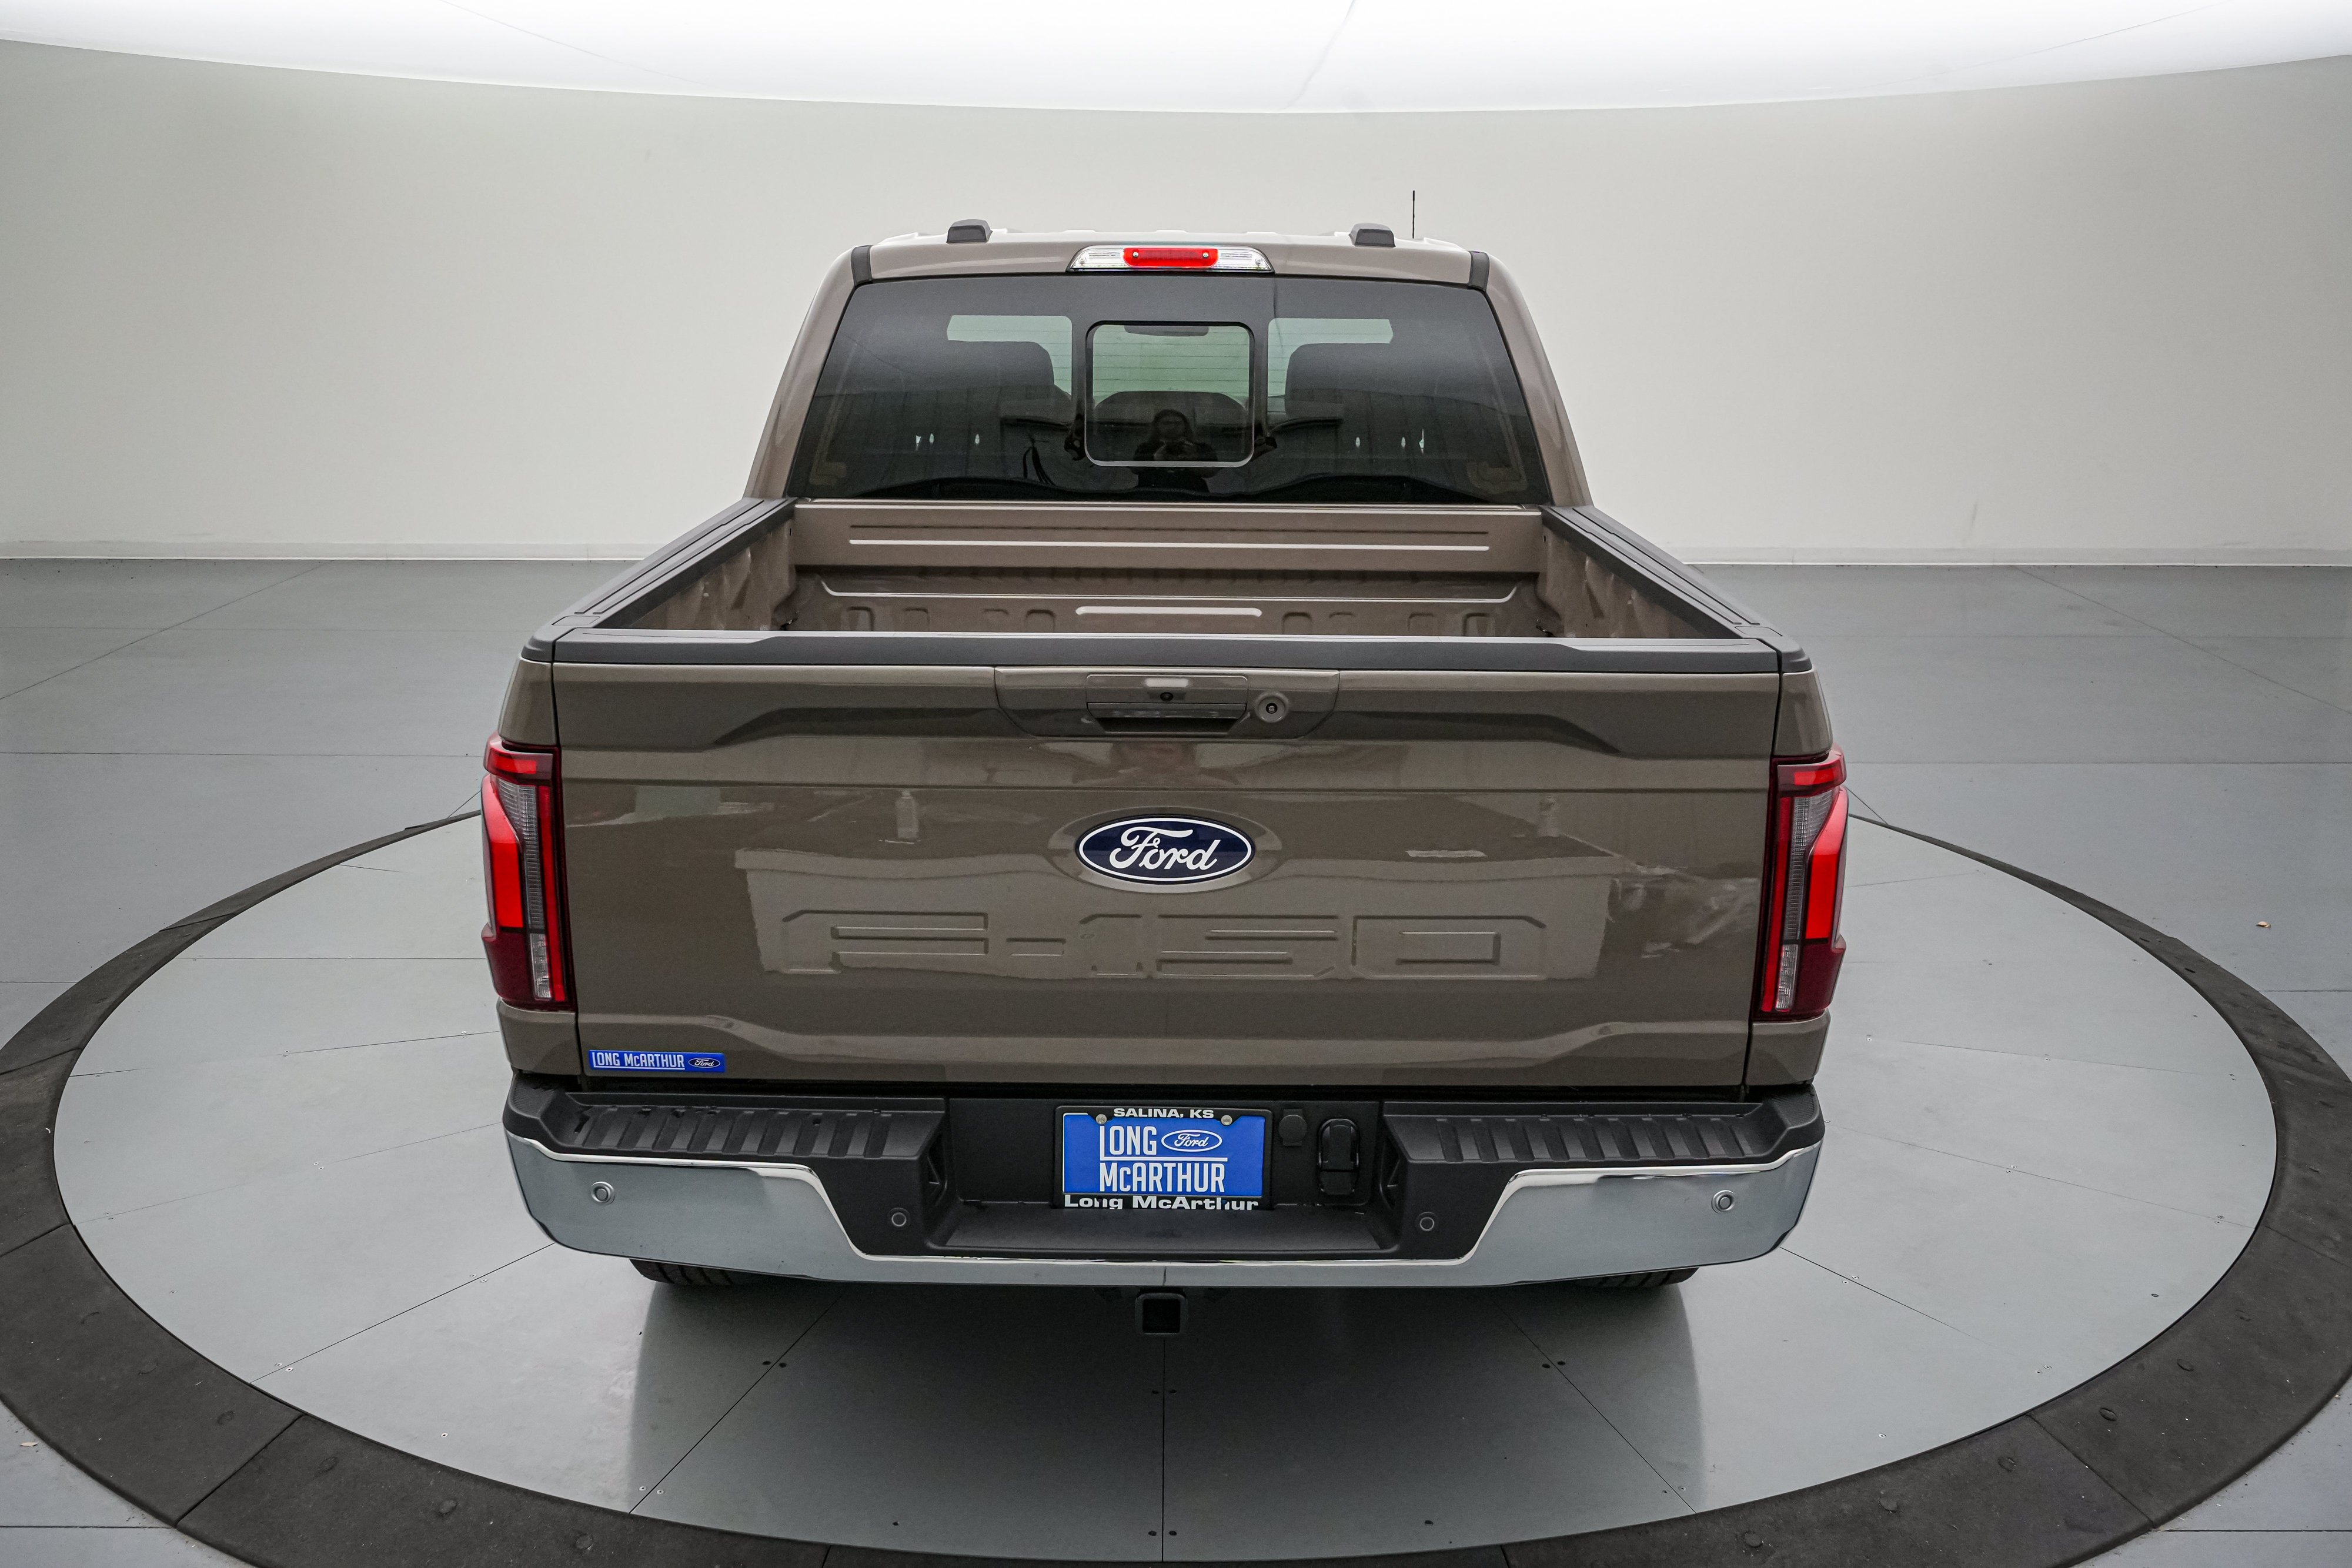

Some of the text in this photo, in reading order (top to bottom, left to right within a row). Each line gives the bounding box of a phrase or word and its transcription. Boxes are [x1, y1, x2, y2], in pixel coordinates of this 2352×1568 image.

[1109, 826, 1221, 870] Ford
[782, 910, 1548, 981] F-150
[592, 1052, 620, 1067] LONG
[624, 1053, 684, 1068] McARTHUR
[1114, 1108, 1214, 1118] SALINA, KS
[1100, 1125, 1211, 1158] LONG Ford
[1100, 1162, 1225, 1193] McARTHUR
[1064, 1194, 1259, 1211] Long McArthur
